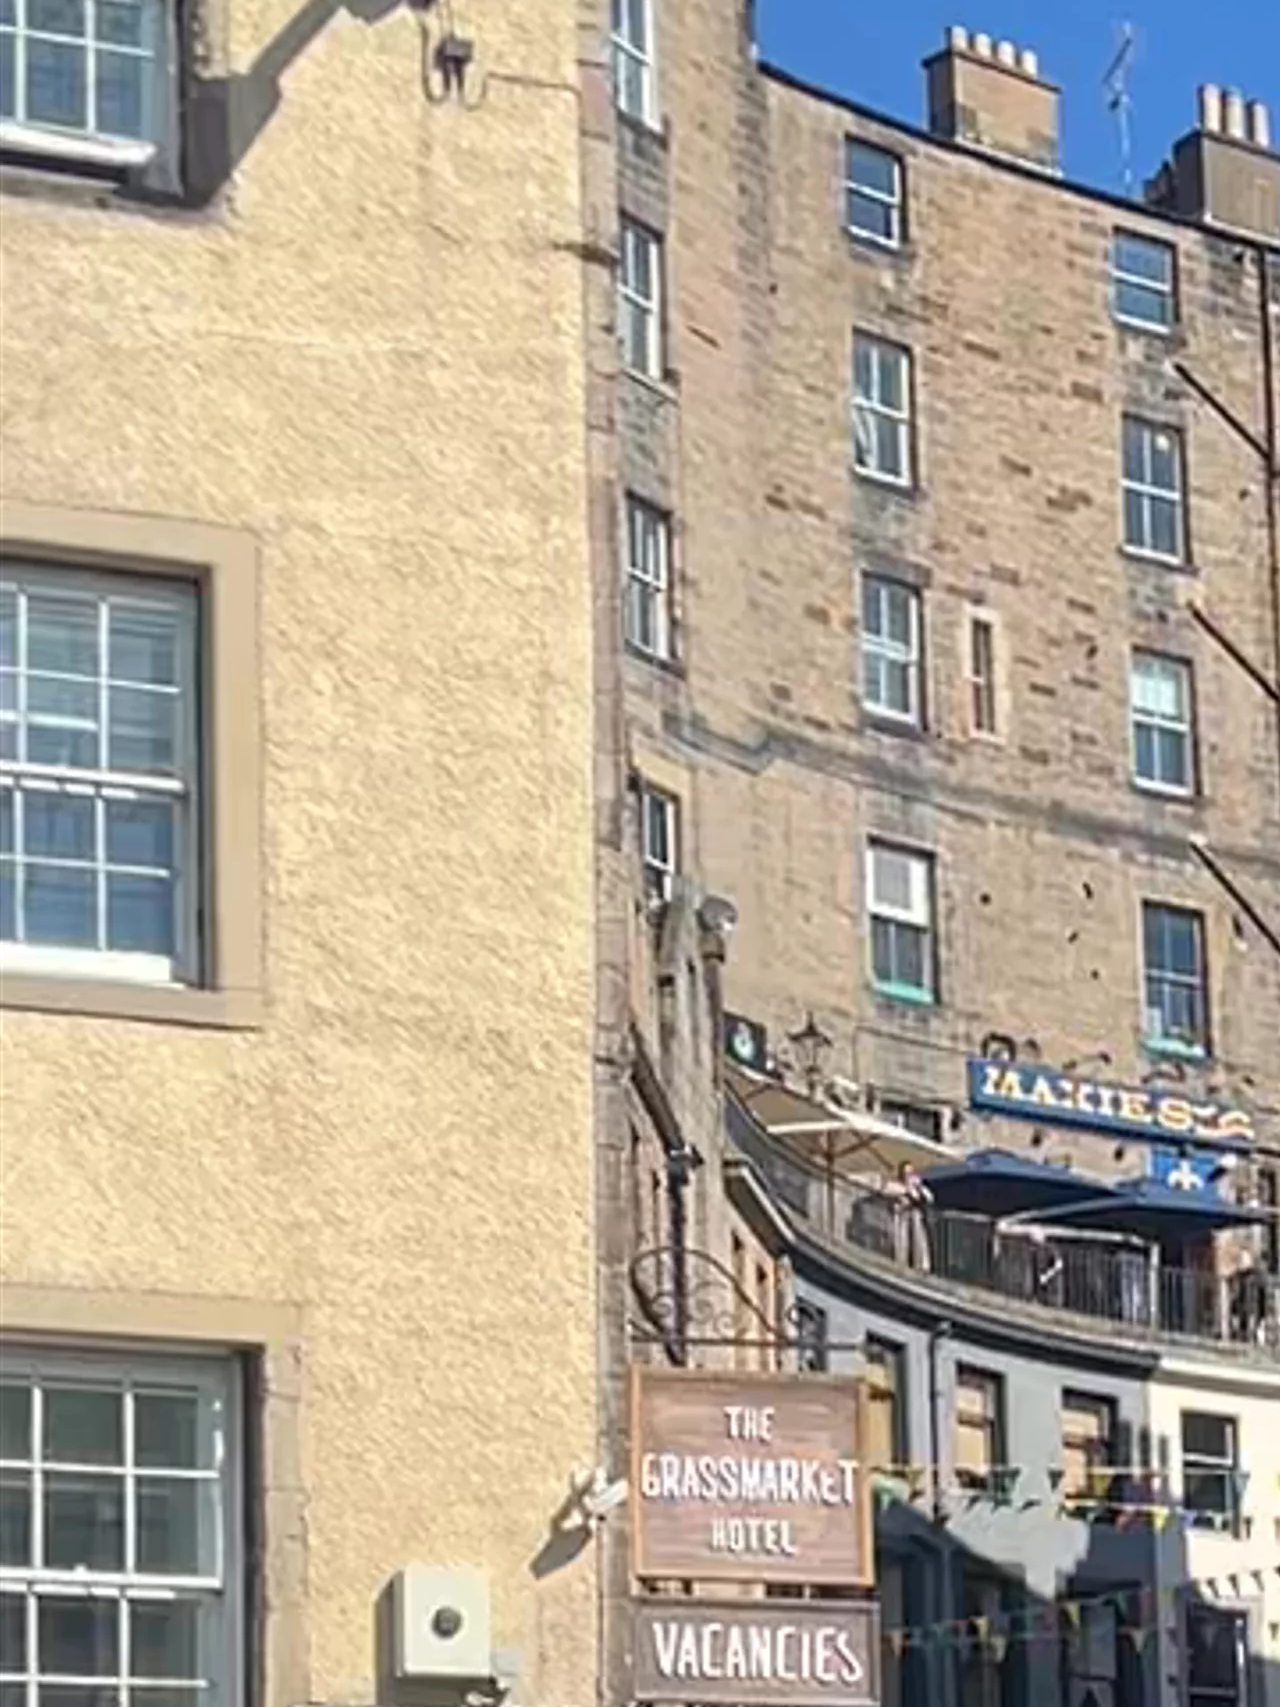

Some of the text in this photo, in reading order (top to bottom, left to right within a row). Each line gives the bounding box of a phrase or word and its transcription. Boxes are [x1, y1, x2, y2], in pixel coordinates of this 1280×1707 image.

[723, 1405, 775, 1441] THE
[641, 1452, 860, 1504] GRASSMARKET
[710, 1518, 797, 1556] HOTEL
[652, 1621, 864, 1682] VACANCIES
